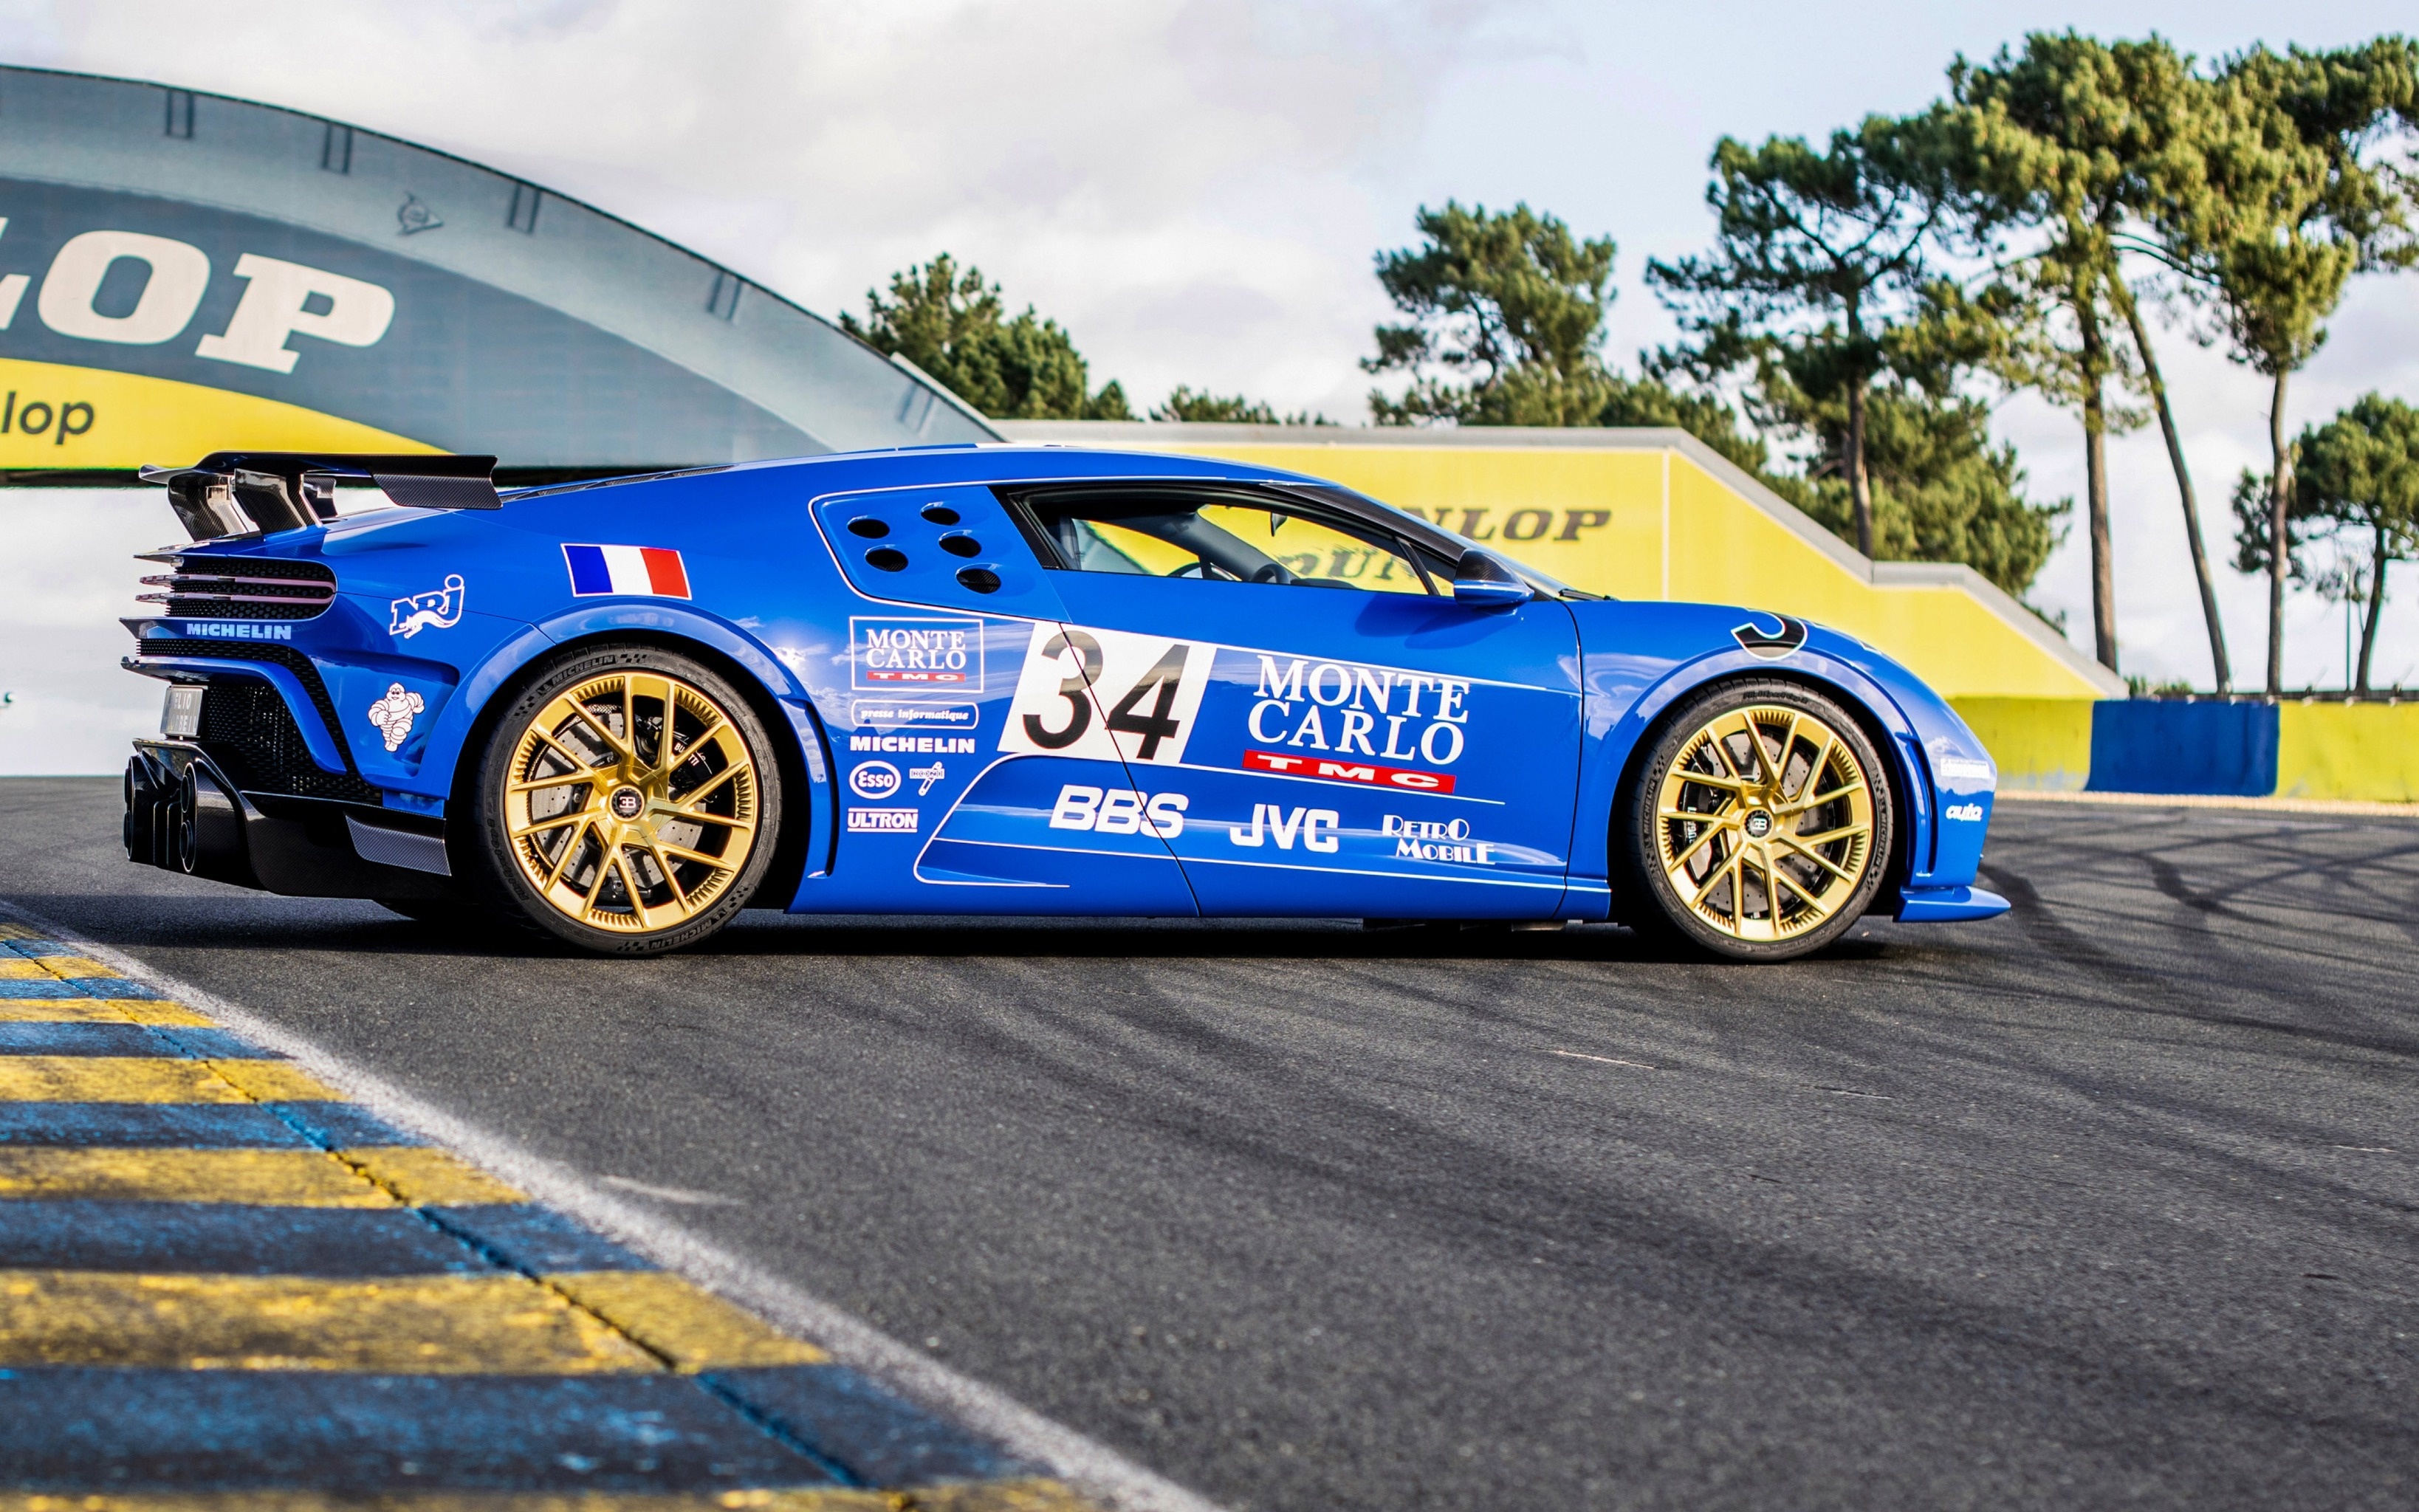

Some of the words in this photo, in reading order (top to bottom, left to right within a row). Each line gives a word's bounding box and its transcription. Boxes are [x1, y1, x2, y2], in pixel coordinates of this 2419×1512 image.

[0, 216, 395, 374] OP
[1, 391, 95, 446] lop
[186, 622, 292, 640] MICHELIN
[866, 629, 966, 650] MONTE
[552, 654, 616, 685] MICHELIN
[866, 648, 967, 670] CARLO
[873, 673, 958, 681] TMC
[1253, 655, 1471, 724] MONTE
[1023, 629, 1190, 760] 34
[860, 709, 894, 719] presse
[898, 709, 969, 721] informatique
[850, 736, 975, 753] MICHELIN
[1248, 699, 1465, 766] CARLO
[858, 771, 894, 788] Esso
[910, 769, 944, 778] KONI
[1256, 754, 1440, 788] TMC
[848, 813, 919, 828] ULTRON
[1049, 784, 1190, 839] BBS
[1643, 780, 1657, 835] MICHELIN
[1229, 803, 1339, 853] JVC
[1876, 813, 1887, 865] MICHELIN
[651, 919, 713, 950] MICHELIN
